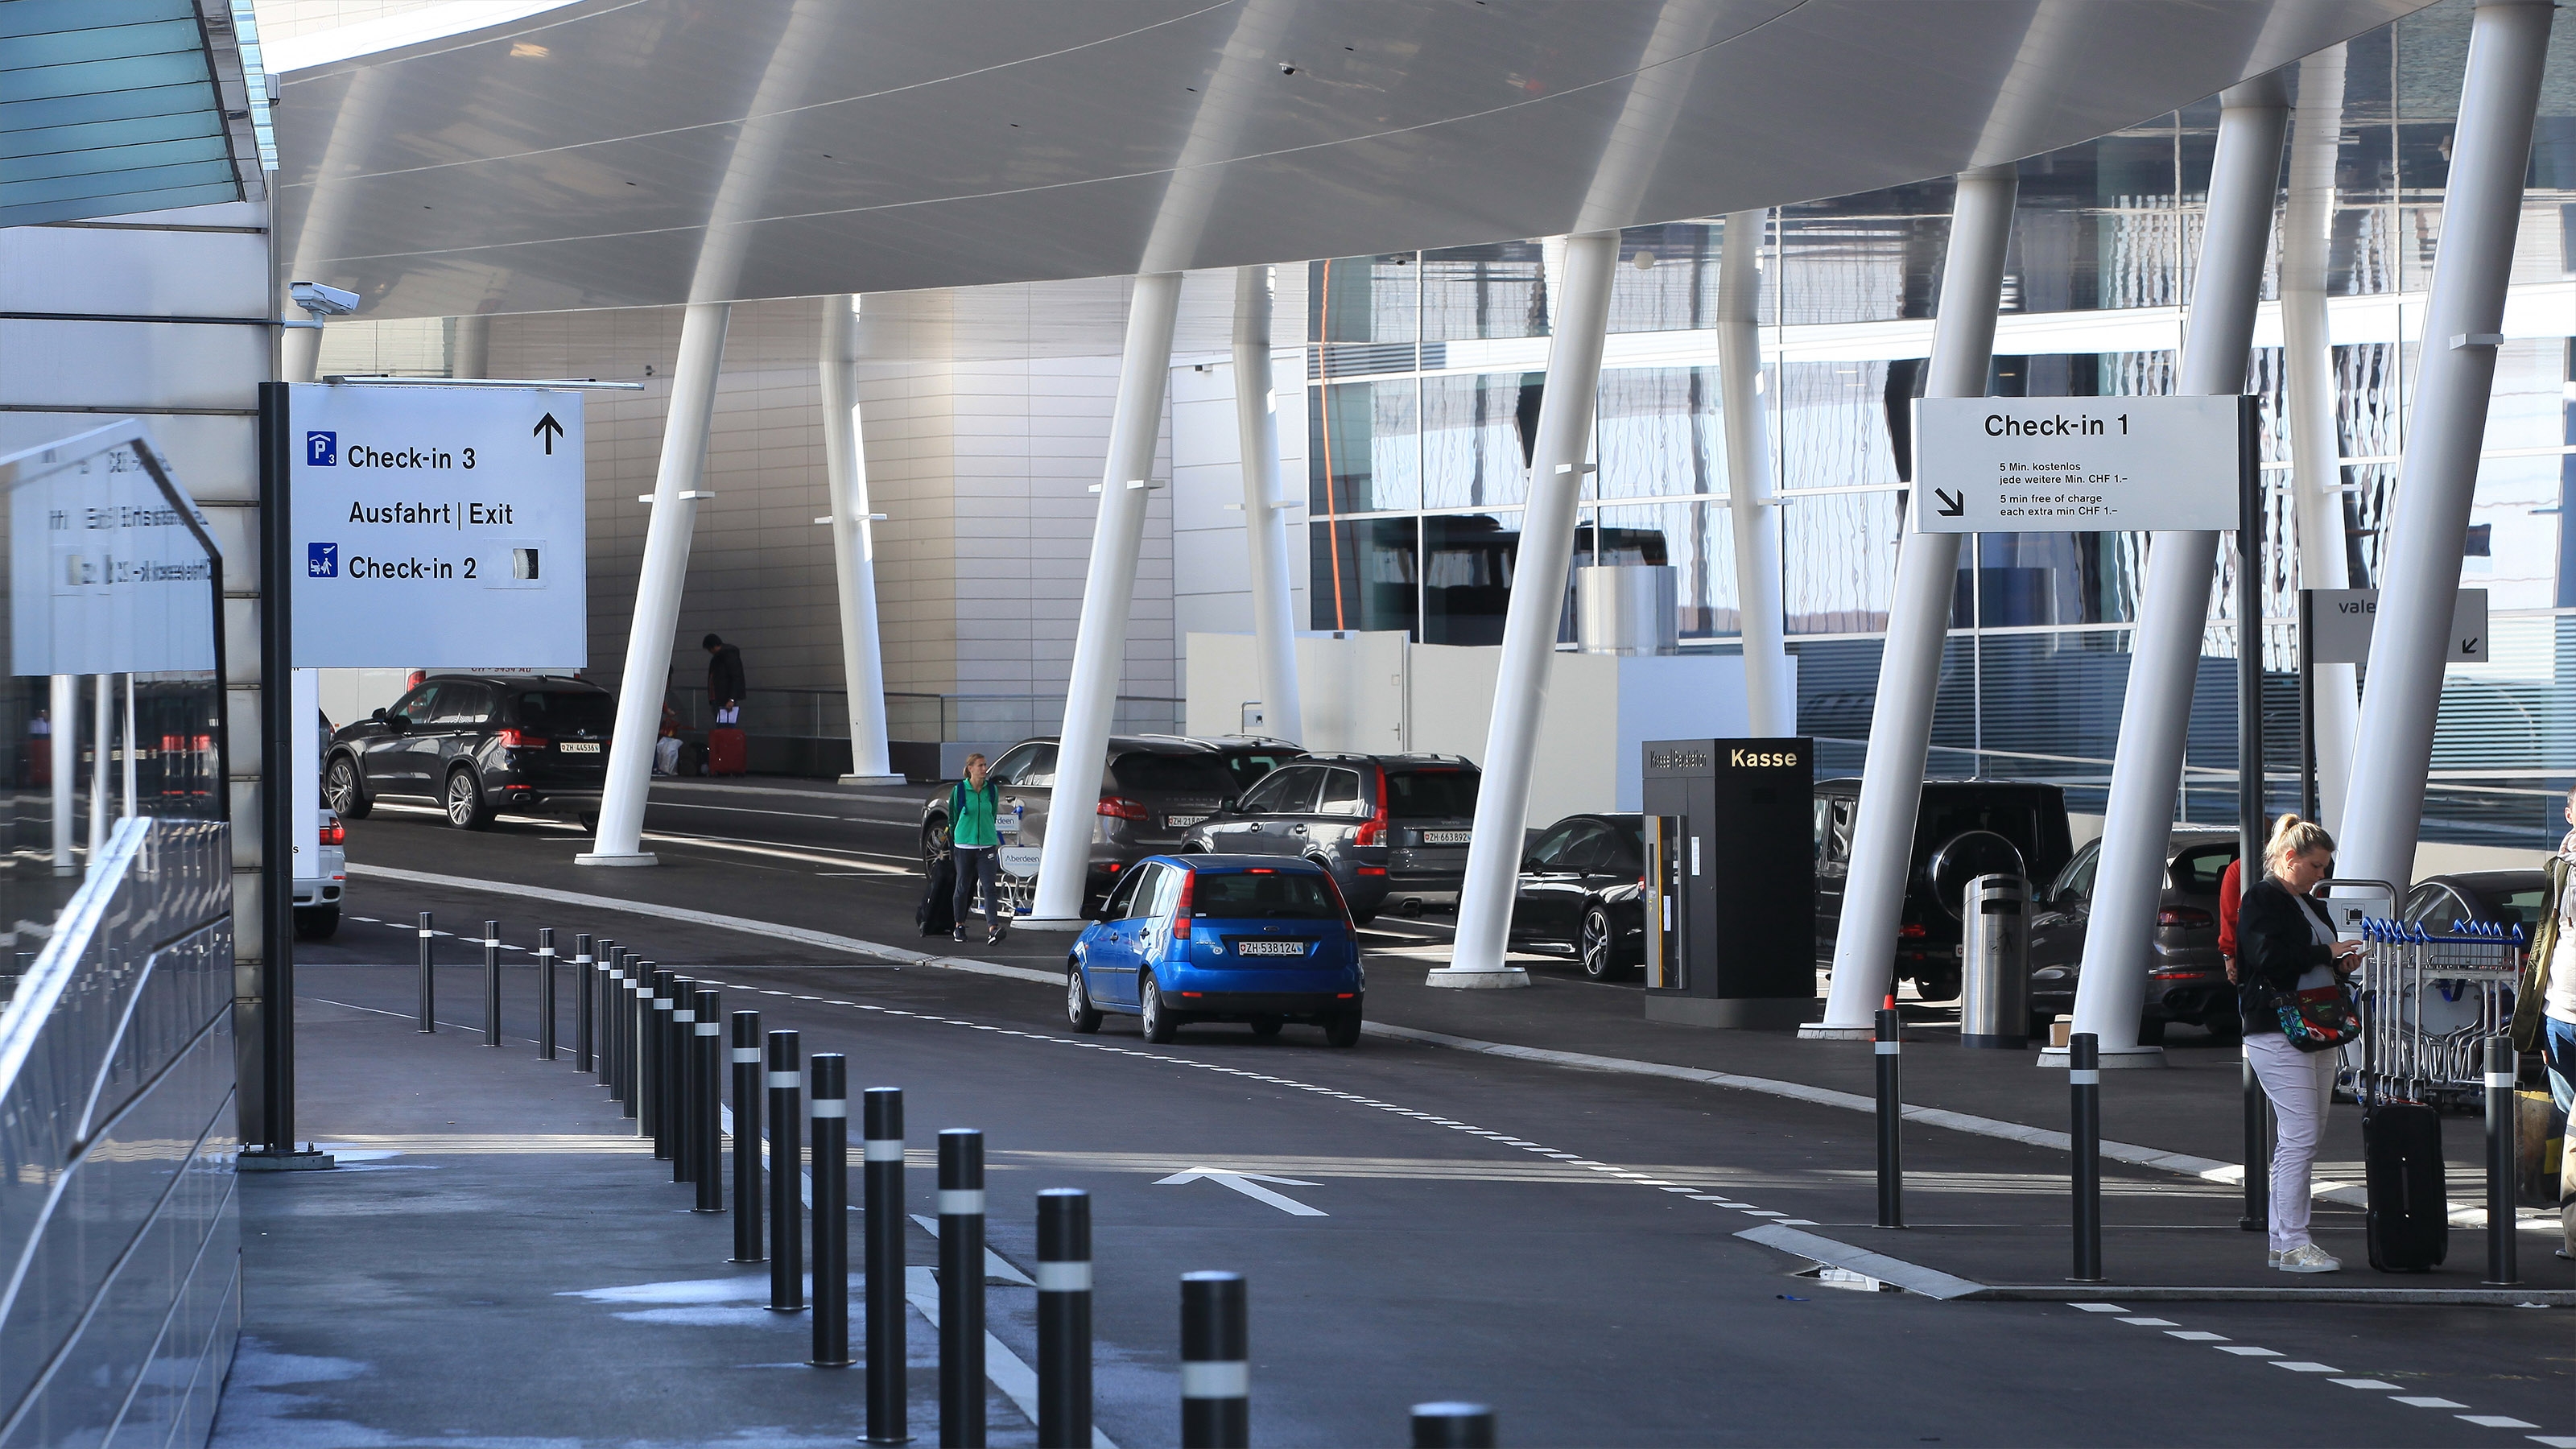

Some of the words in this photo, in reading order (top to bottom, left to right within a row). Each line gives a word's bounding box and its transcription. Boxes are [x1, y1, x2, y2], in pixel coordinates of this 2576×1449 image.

[1984, 414, 2104, 437] Check-in
[2117, 413, 2128, 436] 1
[315, 440, 326, 459] P
[348, 445, 452, 470] Check-in
[462, 448, 477, 470] 3
[2000, 463, 2007, 472] 5
[2009, 463, 2029, 472] Min.
[2033, 462, 2081, 472] kostenlos
[2000, 475, 2021, 486] jede
[2025, 476, 2062, 484] weitere
[2065, 475, 2085, 484] Min.
[2088, 475, 2110, 484] CHF
[2000, 494, 2007, 504] 5
[2009, 494, 2028, 503] min
[2031, 493, 2052, 503] free
[2054, 493, 2065, 503] of
[2067, 493, 2103, 506] charge
[349, 501, 451, 525] Ausfahrt
[469, 502, 514, 525] Exit
[2000, 507, 2025, 516] each
[2029, 508, 2053, 516] extra
[2056, 507, 2075, 516] min
[2078, 506, 2100, 516] CHF
[349, 555, 452, 580] Check-in
[463, 557, 477, 580] 2
[2339, 599, 2376, 613] vale
[1650, 750, 1671, 769] Kasse
[1674, 749, 1707, 771] Paystation
[1731, 749, 1798, 767] Kasse
[1005, 855, 1040, 863] Aberdeen
